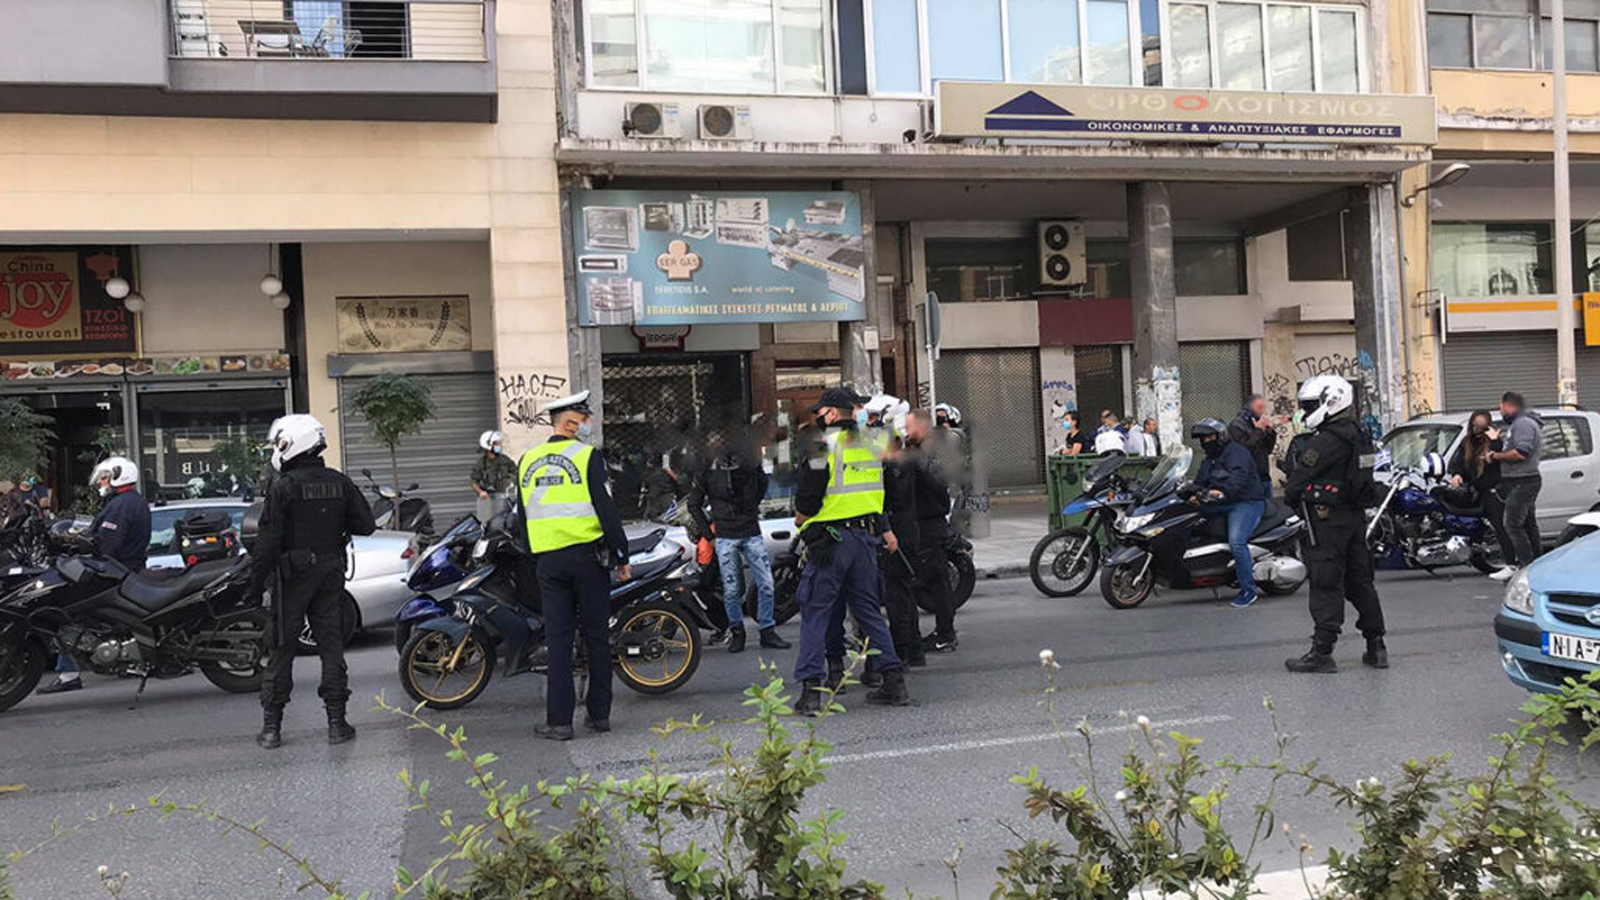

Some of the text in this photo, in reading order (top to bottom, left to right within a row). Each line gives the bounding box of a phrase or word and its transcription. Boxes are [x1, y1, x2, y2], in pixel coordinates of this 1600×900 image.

[1087, 121, 1395, 136] ΟΙΚΟΝΟΜΙΚΕΣ & ΑΝΑΠΤΥΞΙΑΚΕΣ ΕΦΑΡΜΟΓΕΣ
[8, 261, 54, 272] China
[1, 275, 73, 318] joy
